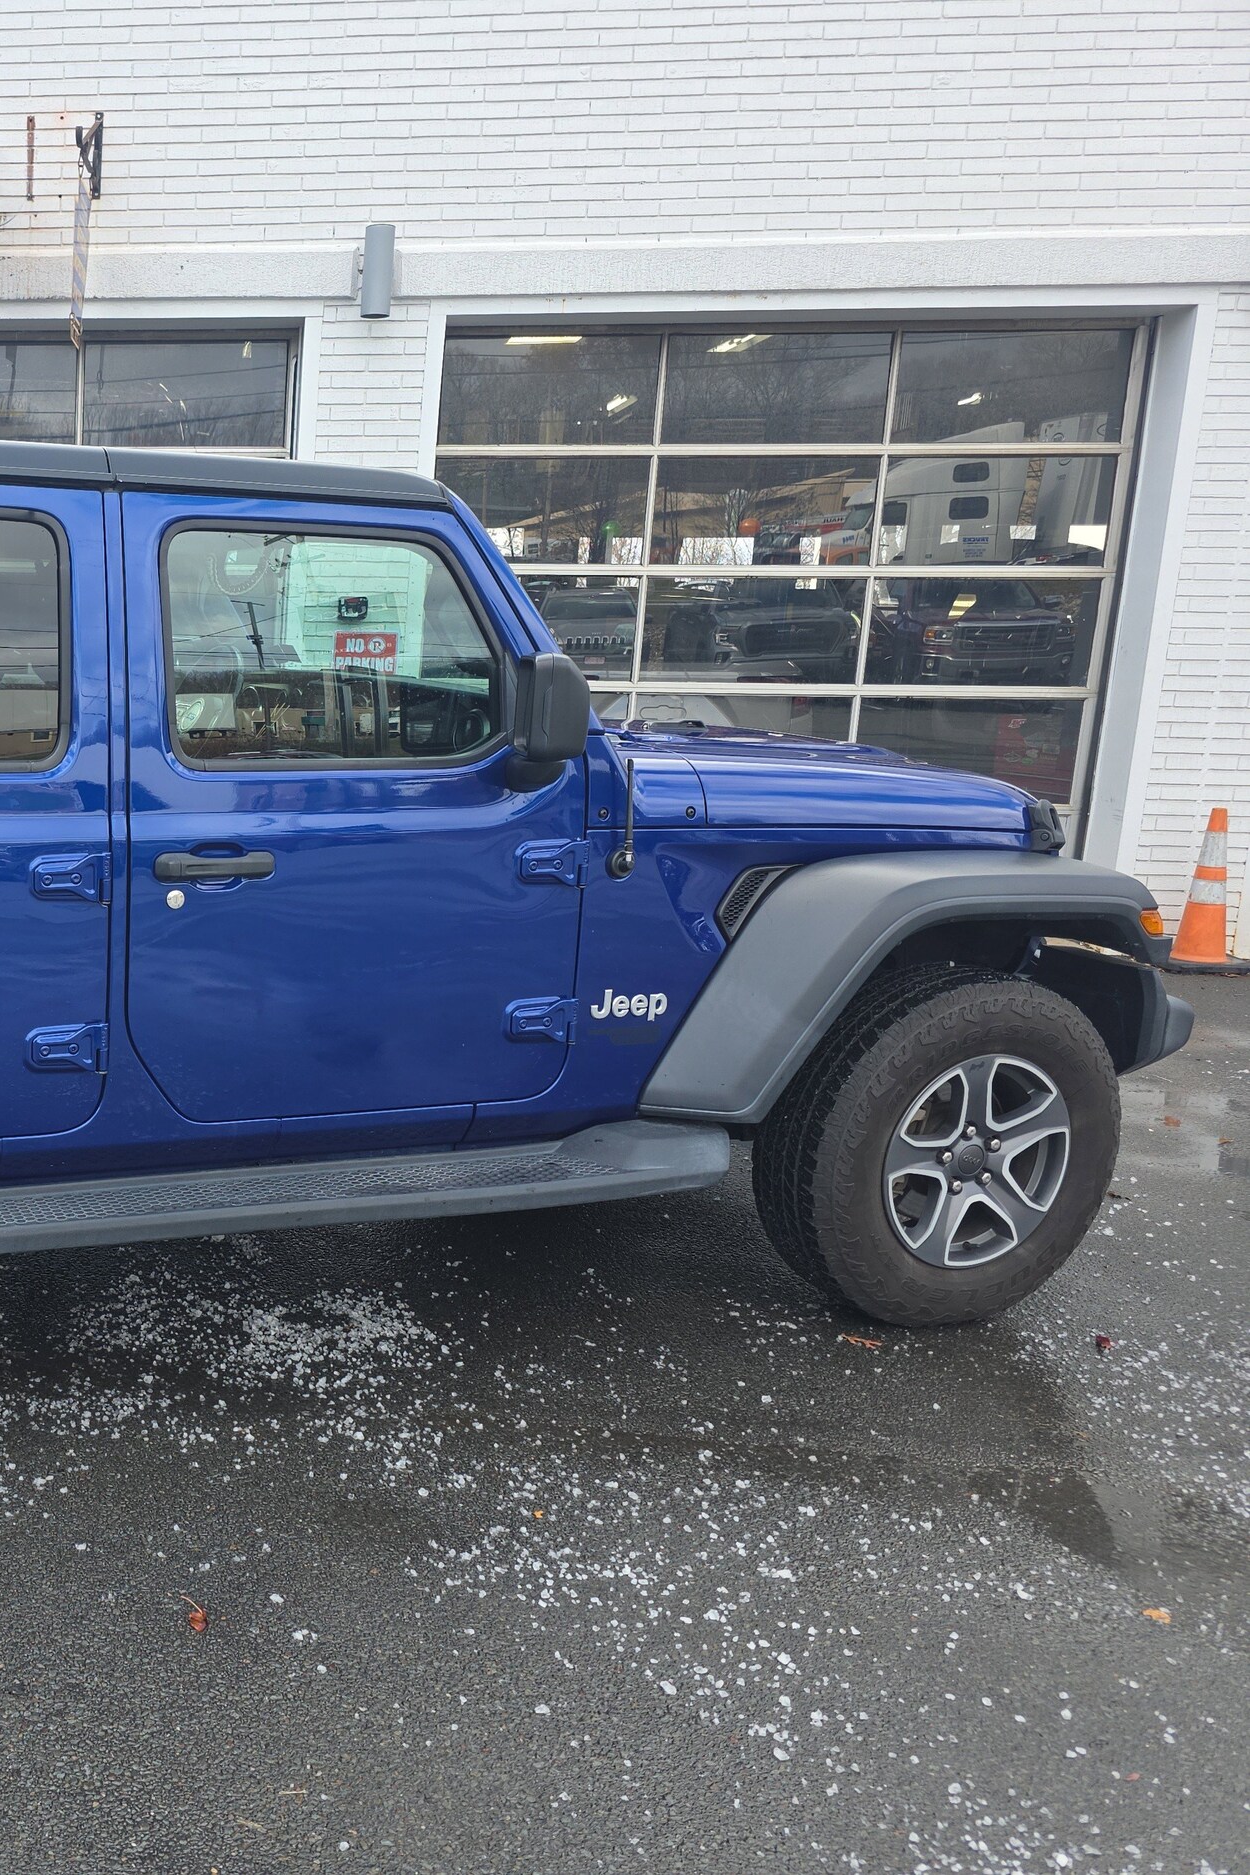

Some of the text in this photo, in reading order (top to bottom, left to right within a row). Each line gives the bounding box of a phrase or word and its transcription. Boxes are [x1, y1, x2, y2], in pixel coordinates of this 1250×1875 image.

[346, 638, 365, 654] NO
[335, 656, 394, 672] PARKING
[590, 989, 668, 1022] Jeep
